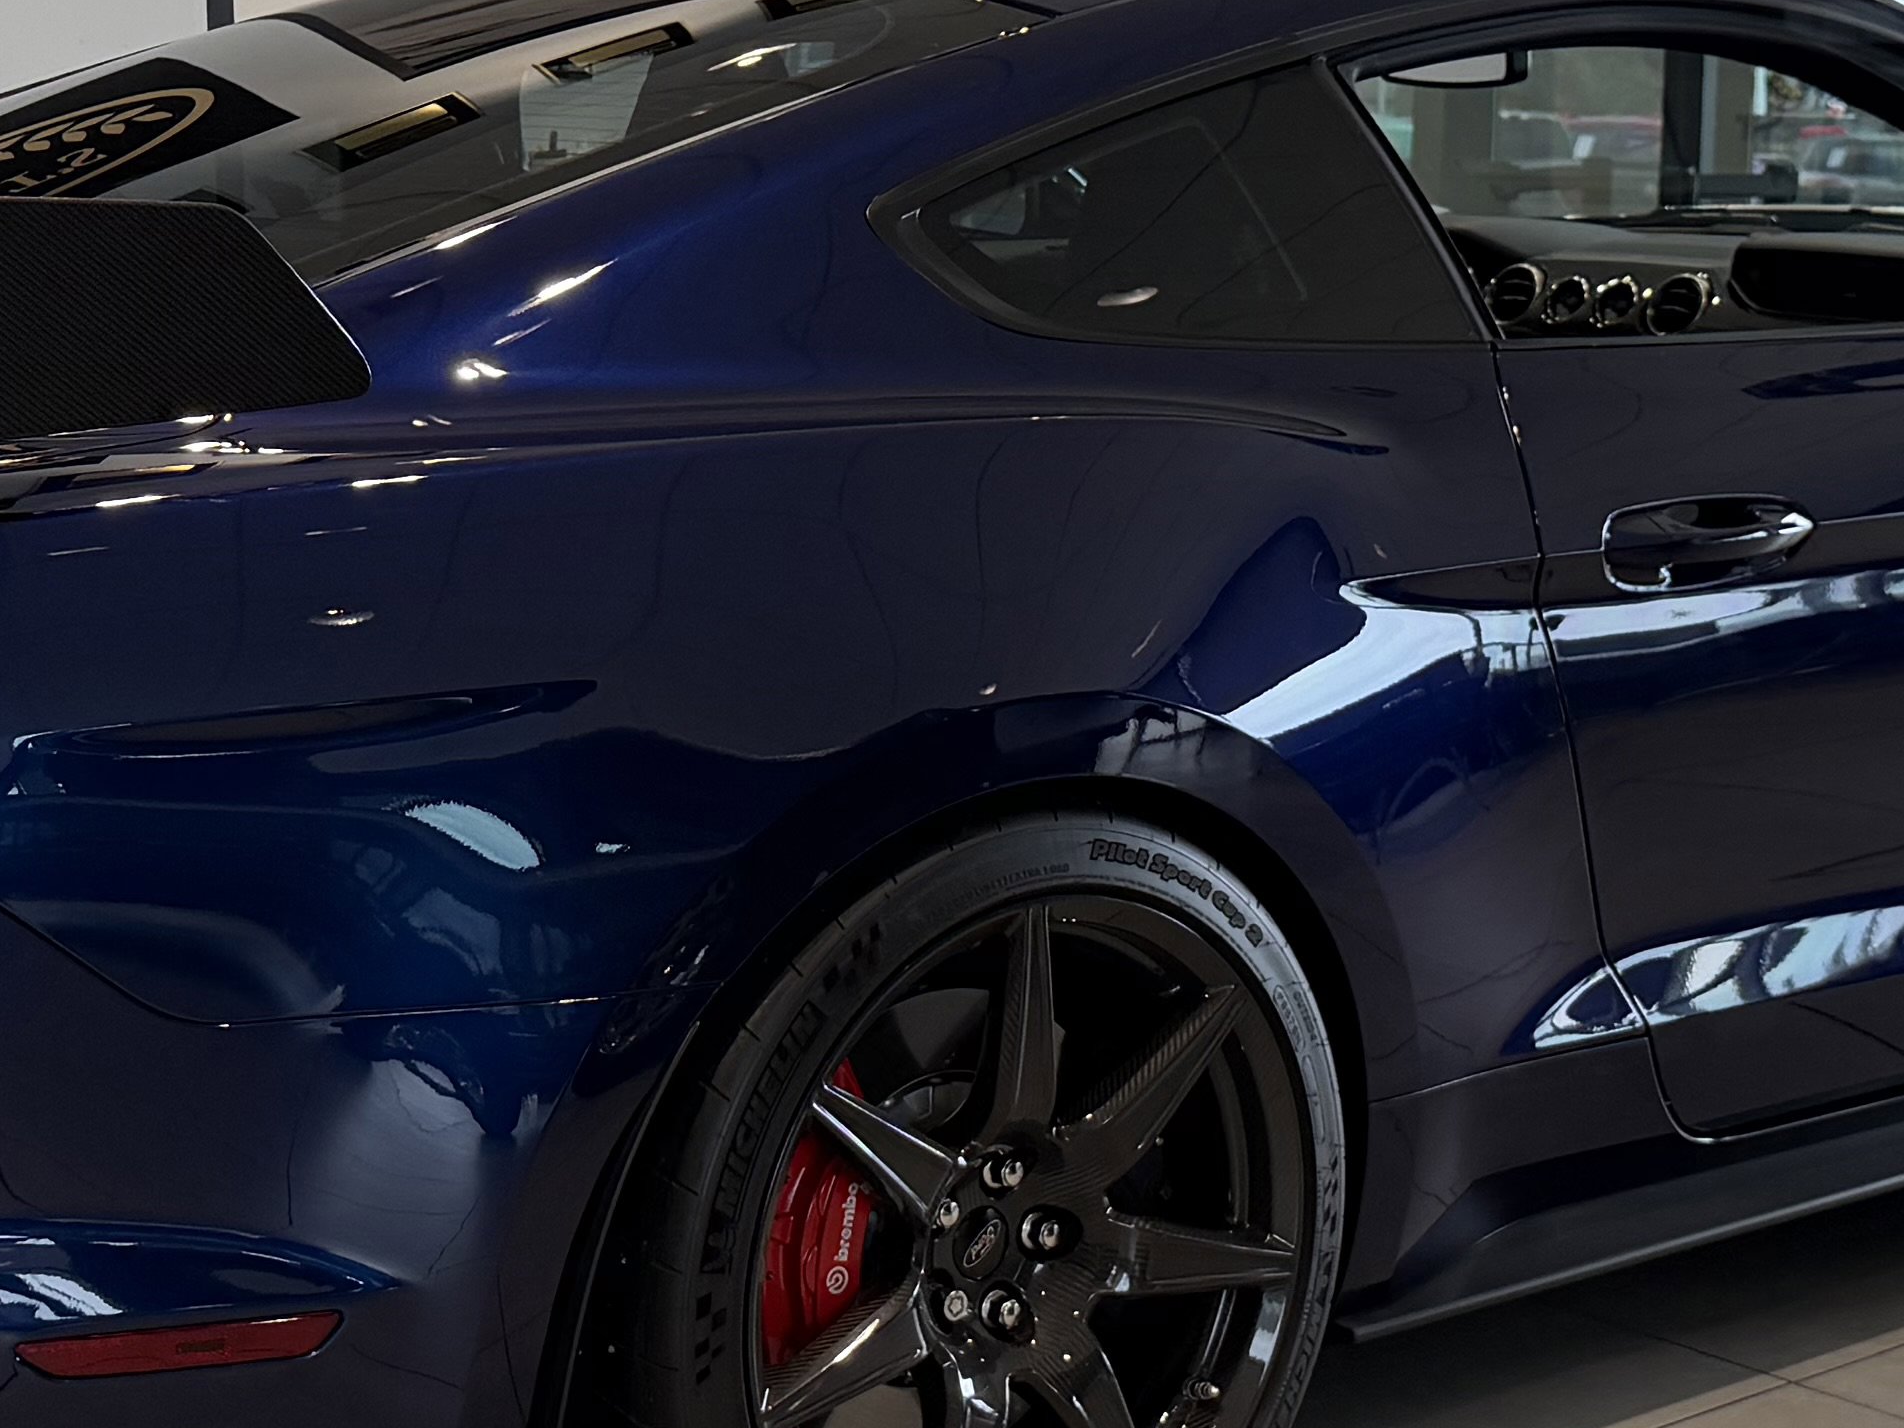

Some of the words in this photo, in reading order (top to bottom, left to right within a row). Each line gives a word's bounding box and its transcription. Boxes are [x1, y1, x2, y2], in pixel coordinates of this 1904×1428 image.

[1148, 852, 1212, 900] Sport
[1212, 890, 1246, 930] Cup
[1245, 924, 1264, 948] 2
[834, 1182, 860, 1262] brembo
